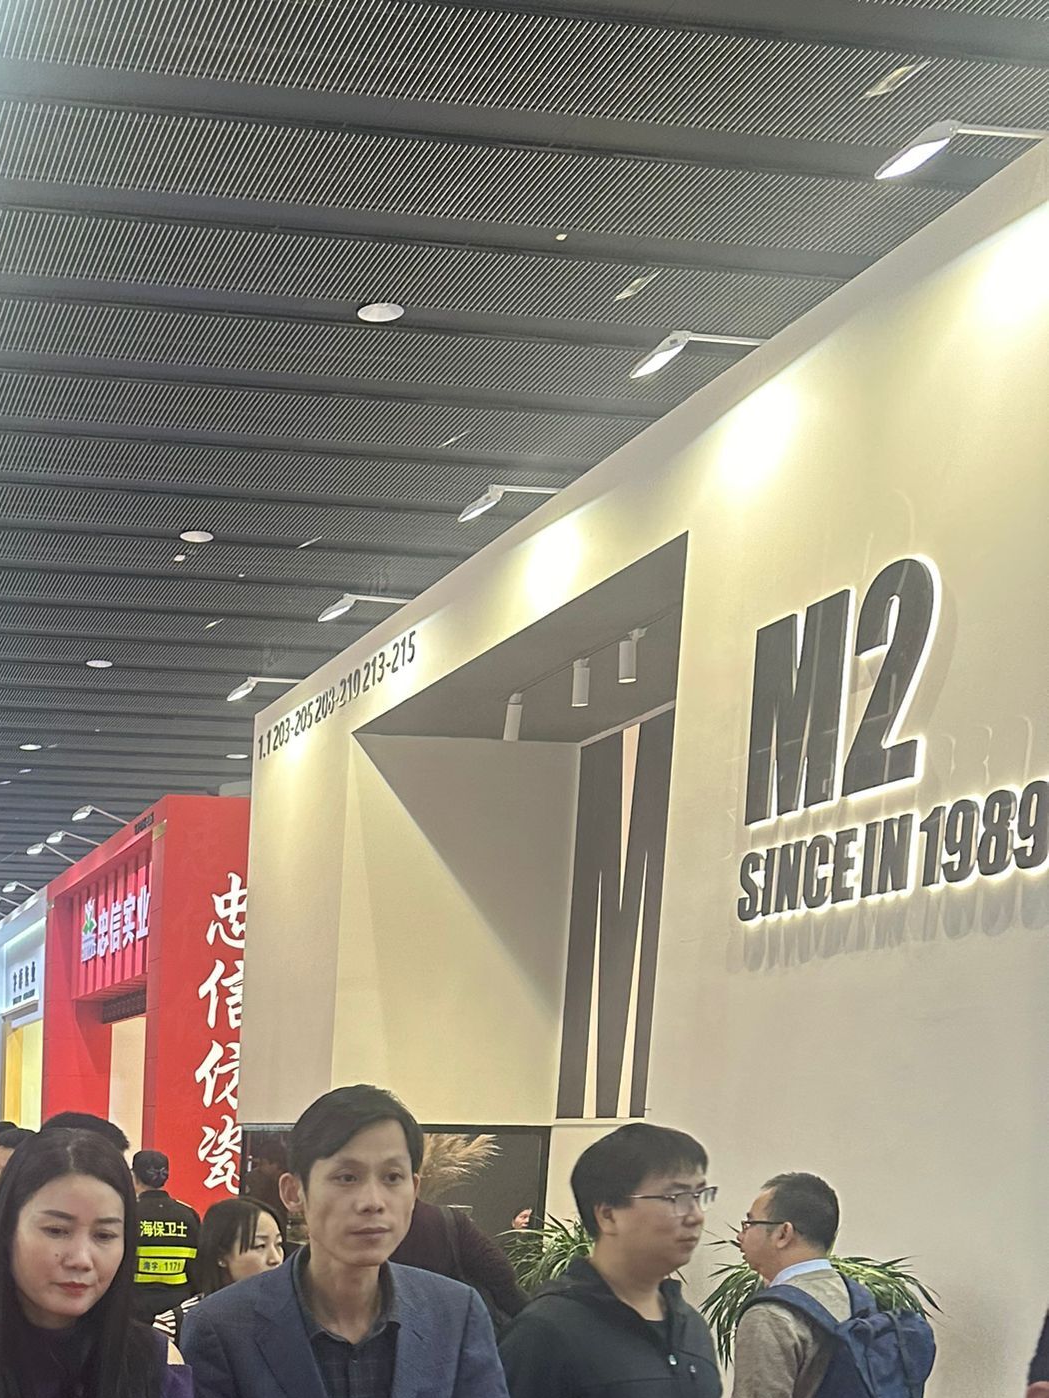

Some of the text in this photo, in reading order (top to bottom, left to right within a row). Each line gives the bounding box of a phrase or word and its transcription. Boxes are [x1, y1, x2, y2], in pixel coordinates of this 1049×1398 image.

[273, 701, 314, 751] 203-205
[362, 630, 416, 693] 213-215
[745, 558, 935, 827] M2
[737, 779, 1049, 922] SINCE IN 1989
[97, 884, 151, 957] 忠信实业
[139, 1220, 188, 1238] 海保卫士
